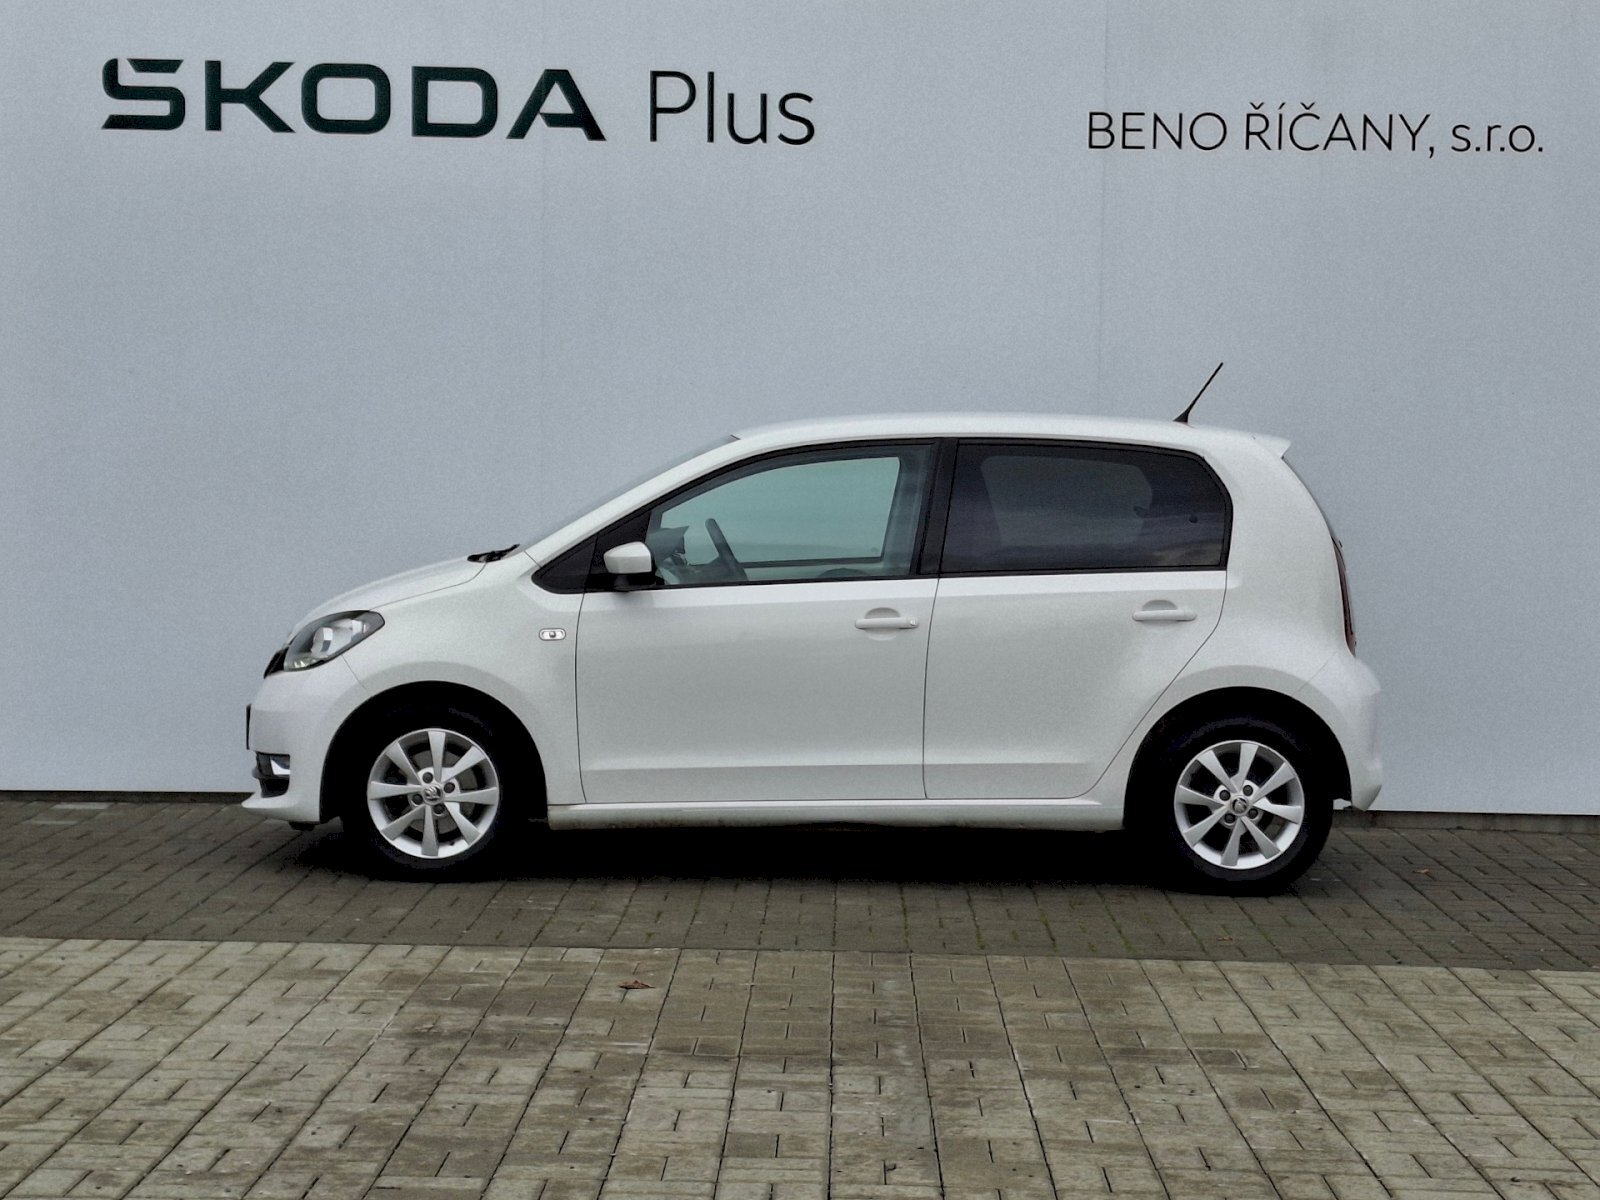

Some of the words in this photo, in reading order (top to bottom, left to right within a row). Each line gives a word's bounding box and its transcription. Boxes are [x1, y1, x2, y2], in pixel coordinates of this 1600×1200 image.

[650, 70, 816, 146] Plus
[1088, 111, 1228, 151] BENO
[1245, 101, 1435, 160] ŘÍČANY,
[1451, 123, 1544, 153] s.r.o.
